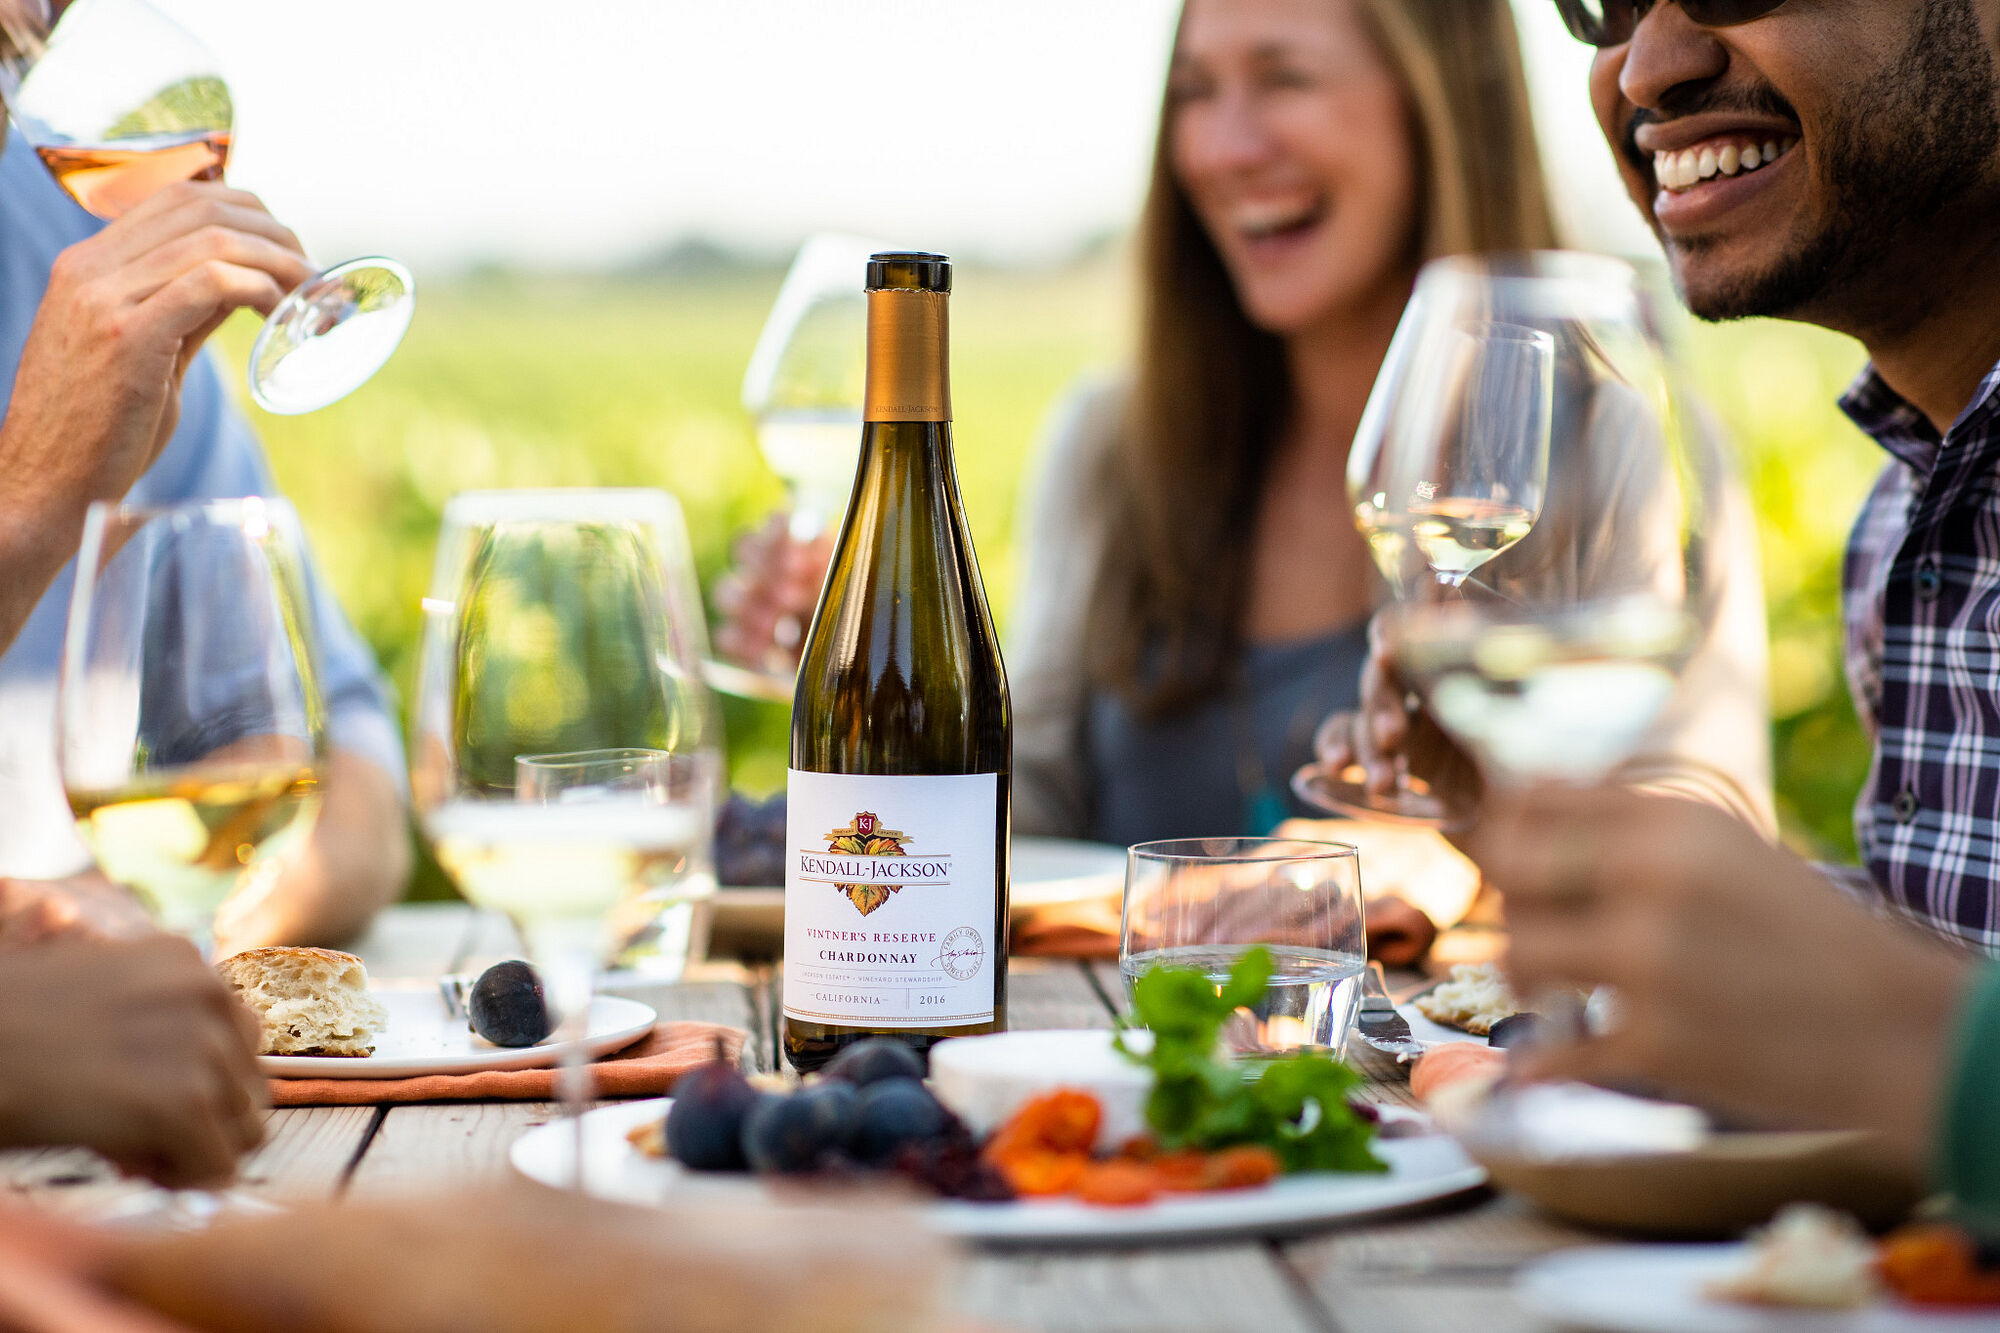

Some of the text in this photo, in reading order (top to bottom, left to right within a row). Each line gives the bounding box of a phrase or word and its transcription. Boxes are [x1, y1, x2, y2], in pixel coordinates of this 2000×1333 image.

[807, 928, 936, 943] VINTNER'S RESERVE
[819, 950, 917, 964] CHARDONNAY
[816, 992, 945, 1005] CALIFORNIA 2016
